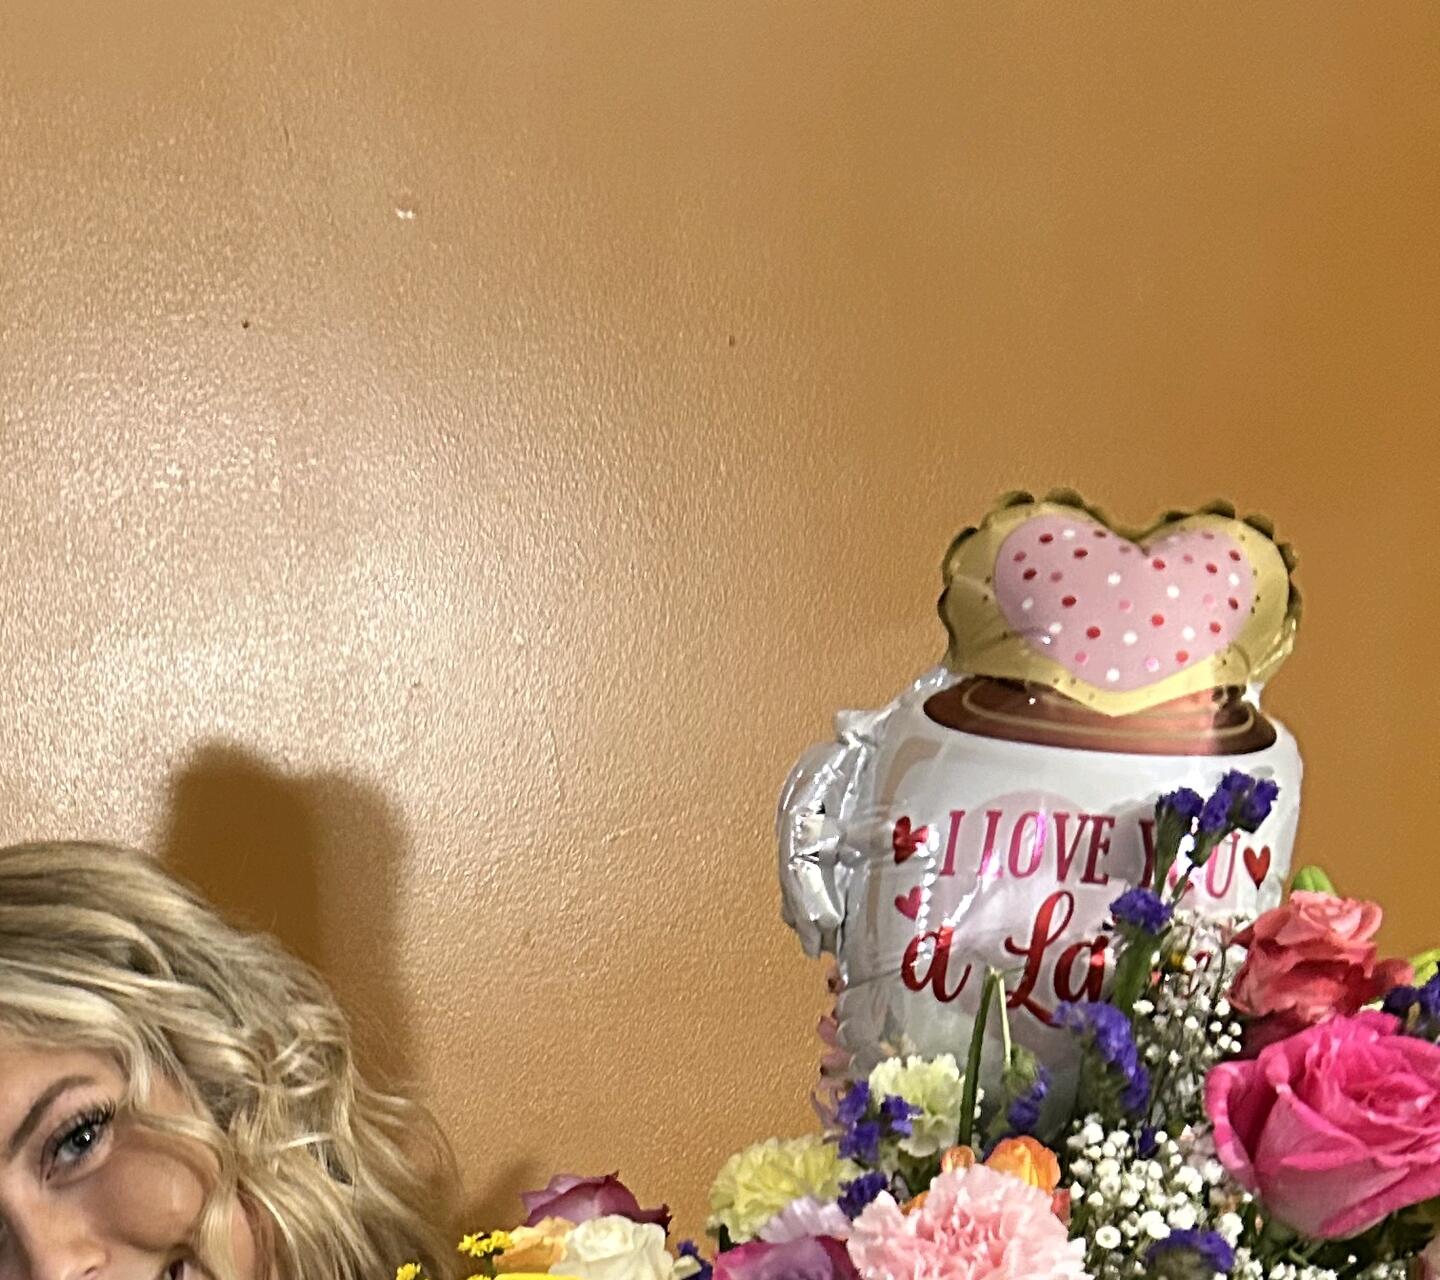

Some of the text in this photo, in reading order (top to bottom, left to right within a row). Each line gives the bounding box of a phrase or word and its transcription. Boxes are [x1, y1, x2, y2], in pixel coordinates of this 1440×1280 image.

[939, 809, 1241, 899] I LOVE YU
[901, 925, 972, 1003] a
